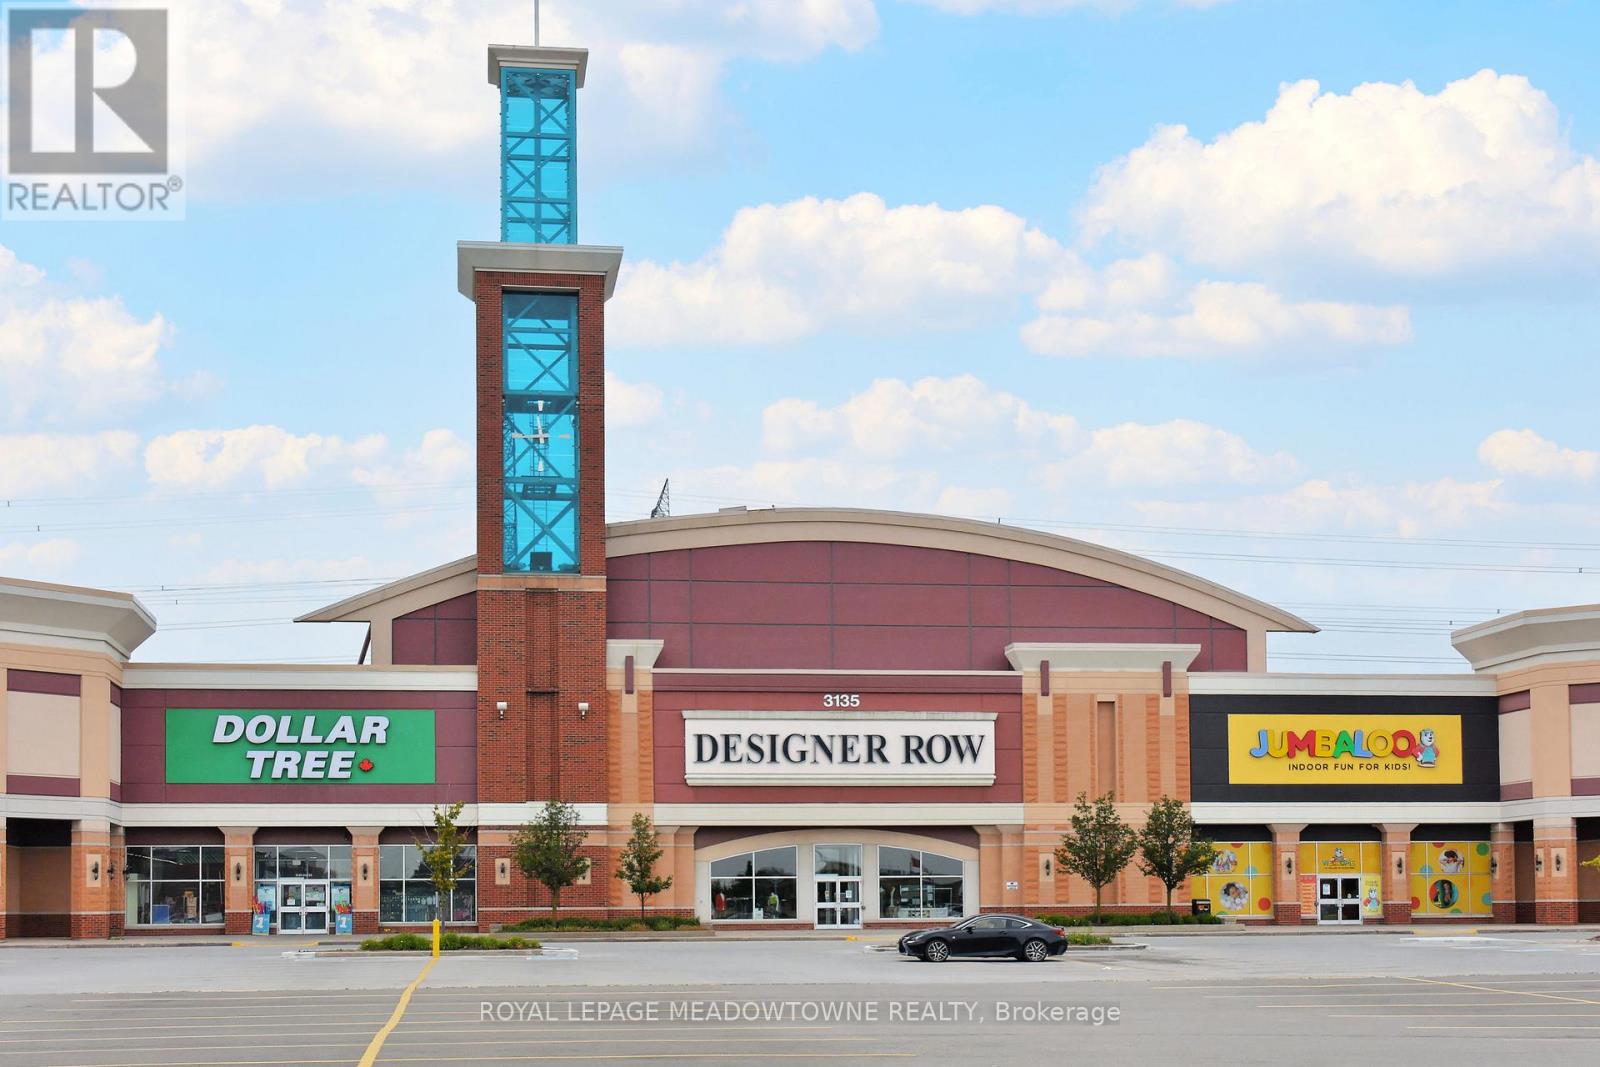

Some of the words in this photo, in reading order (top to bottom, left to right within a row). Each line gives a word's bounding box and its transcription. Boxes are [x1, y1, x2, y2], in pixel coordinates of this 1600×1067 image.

[823, 694, 860, 708] 3135
[212, 714, 390, 744] DOLLAR
[1249, 728, 1417, 759] JUMBALOO
[693, 733, 889, 765] DESIGNER
[901, 733, 985, 765] ROW
[246, 750, 356, 779] TREE
[1288, 763, 1329, 771] INDOOR
[1334, 763, 1354, 771] FUN
[1359, 763, 1379, 771] FOR
[1384, 763, 1411, 771] KIDS!
